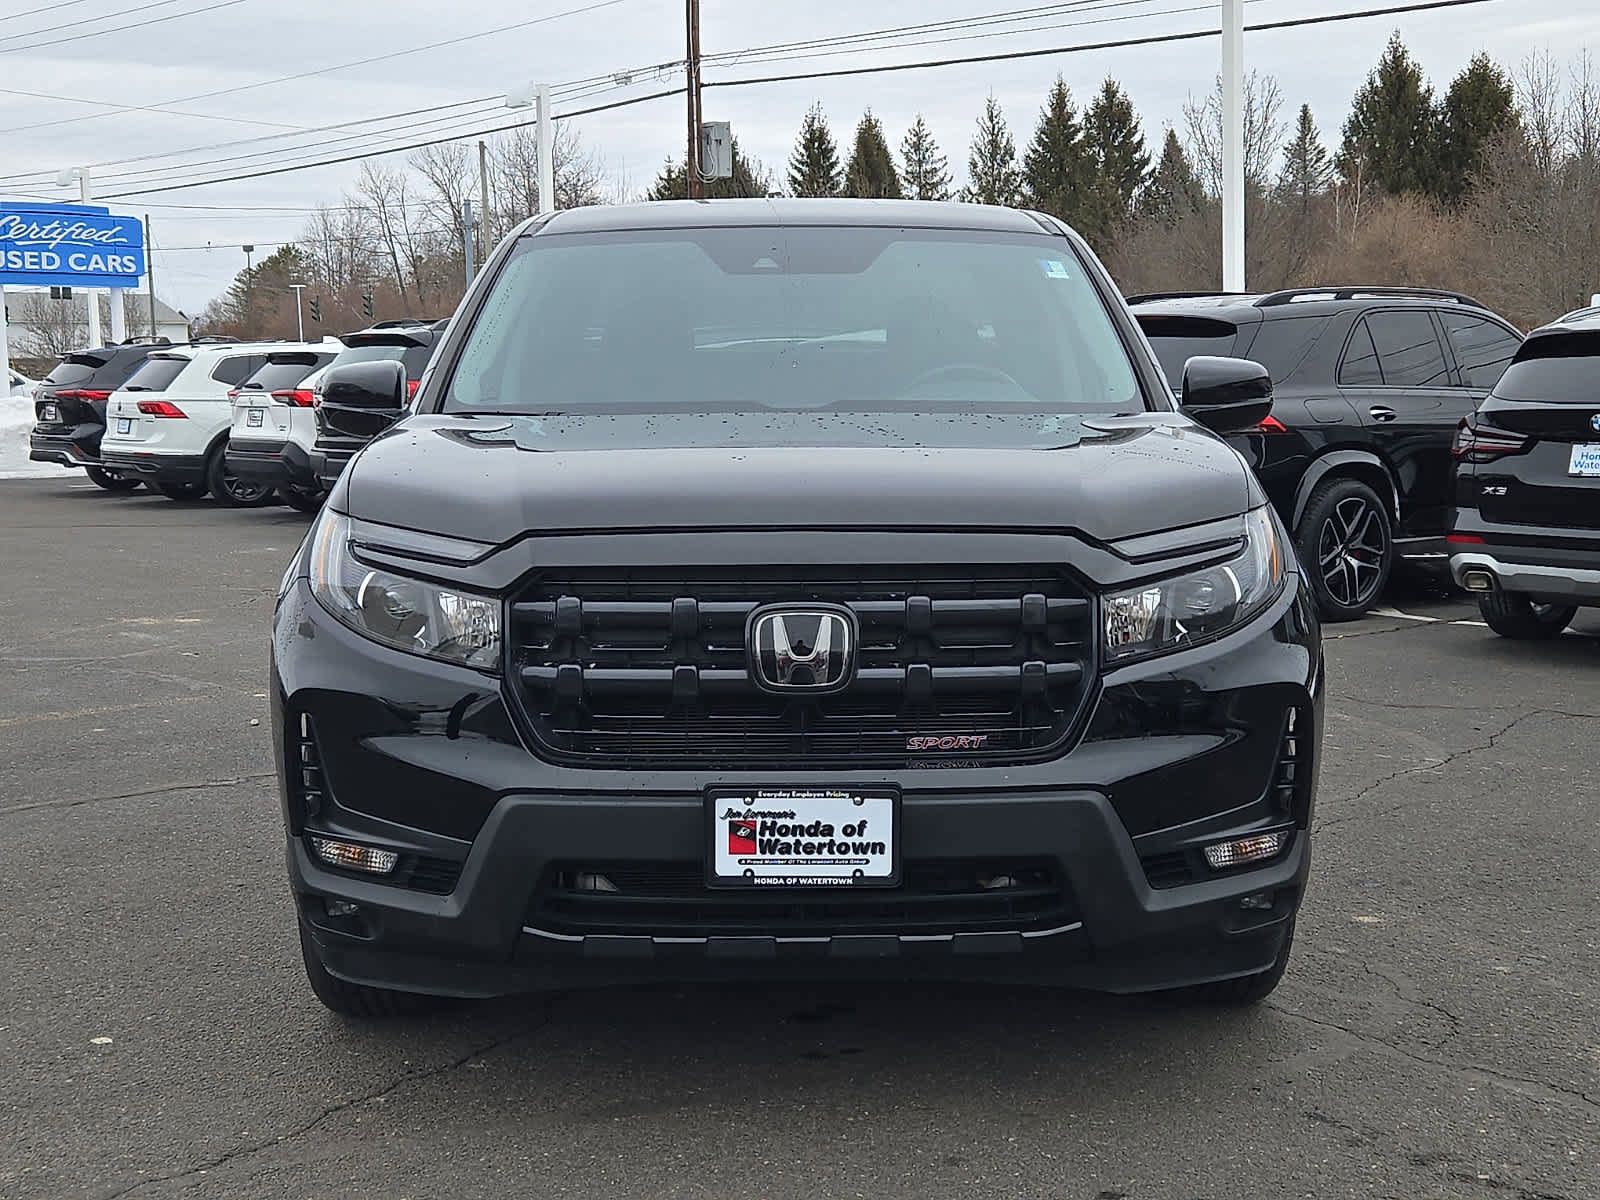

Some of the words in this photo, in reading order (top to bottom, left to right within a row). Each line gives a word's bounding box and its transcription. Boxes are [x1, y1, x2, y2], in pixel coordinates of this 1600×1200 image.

[0, 215, 128, 250] Certified
[68, 253, 137, 273] CARS
[1481, 486, 1508, 496] X3
[906, 735, 987, 749] SPORT
[758, 791, 790, 799] Everyday
[792, 791, 825, 799] Employee
[826, 791, 850, 799] Pricing
[758, 820, 834, 837] Honda
[841, 819, 868, 837] of
[758, 838, 886, 855] Watertown
